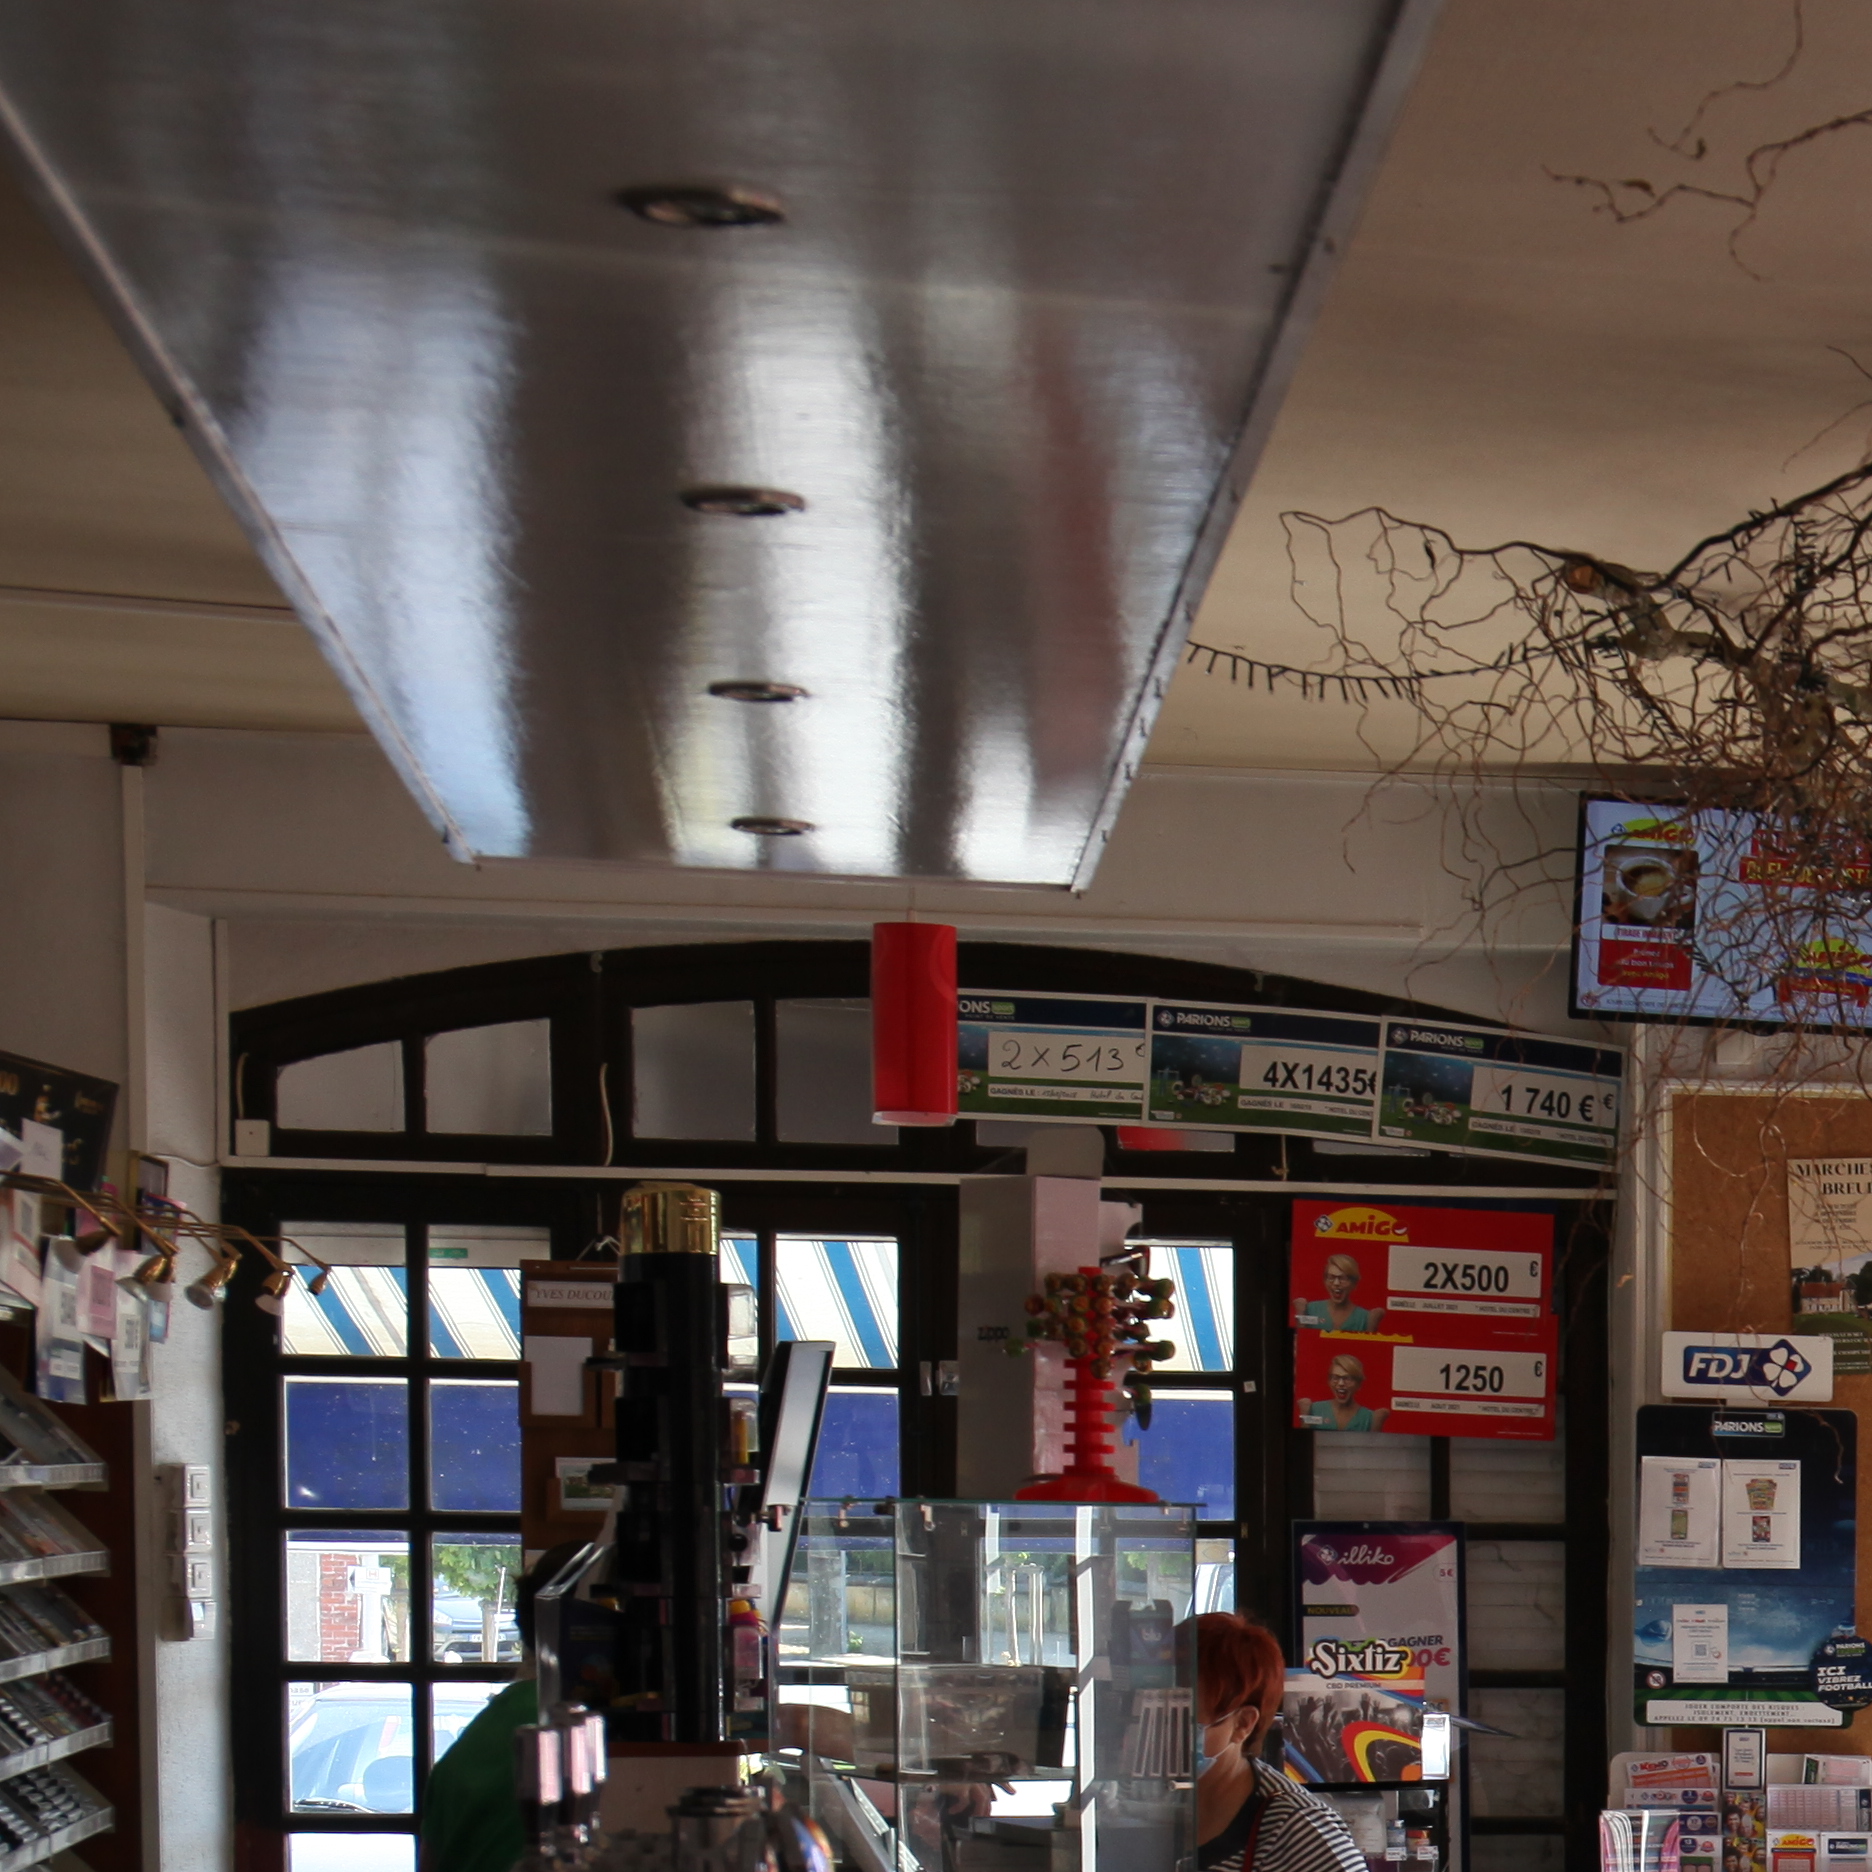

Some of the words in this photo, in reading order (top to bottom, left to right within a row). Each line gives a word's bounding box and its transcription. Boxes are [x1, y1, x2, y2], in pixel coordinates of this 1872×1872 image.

[1176, 1012, 1231, 1028] PARIONS
[1409, 1029, 1463, 1047] PARIONS
[1422, 1261, 1509, 1294] 2X500
[1688, 1352, 1755, 1379] FDJ
[1439, 1362, 1505, 1393] 1250
[1712, 1420, 1764, 1433] PARIONS
[1338, 1544, 1394, 1565] illiko
[1310, 1642, 1402, 1676] Sixtiz
[1817, 1665, 1847, 1677] ICI
[1817, 1675, 1862, 1685] VIBREZ
